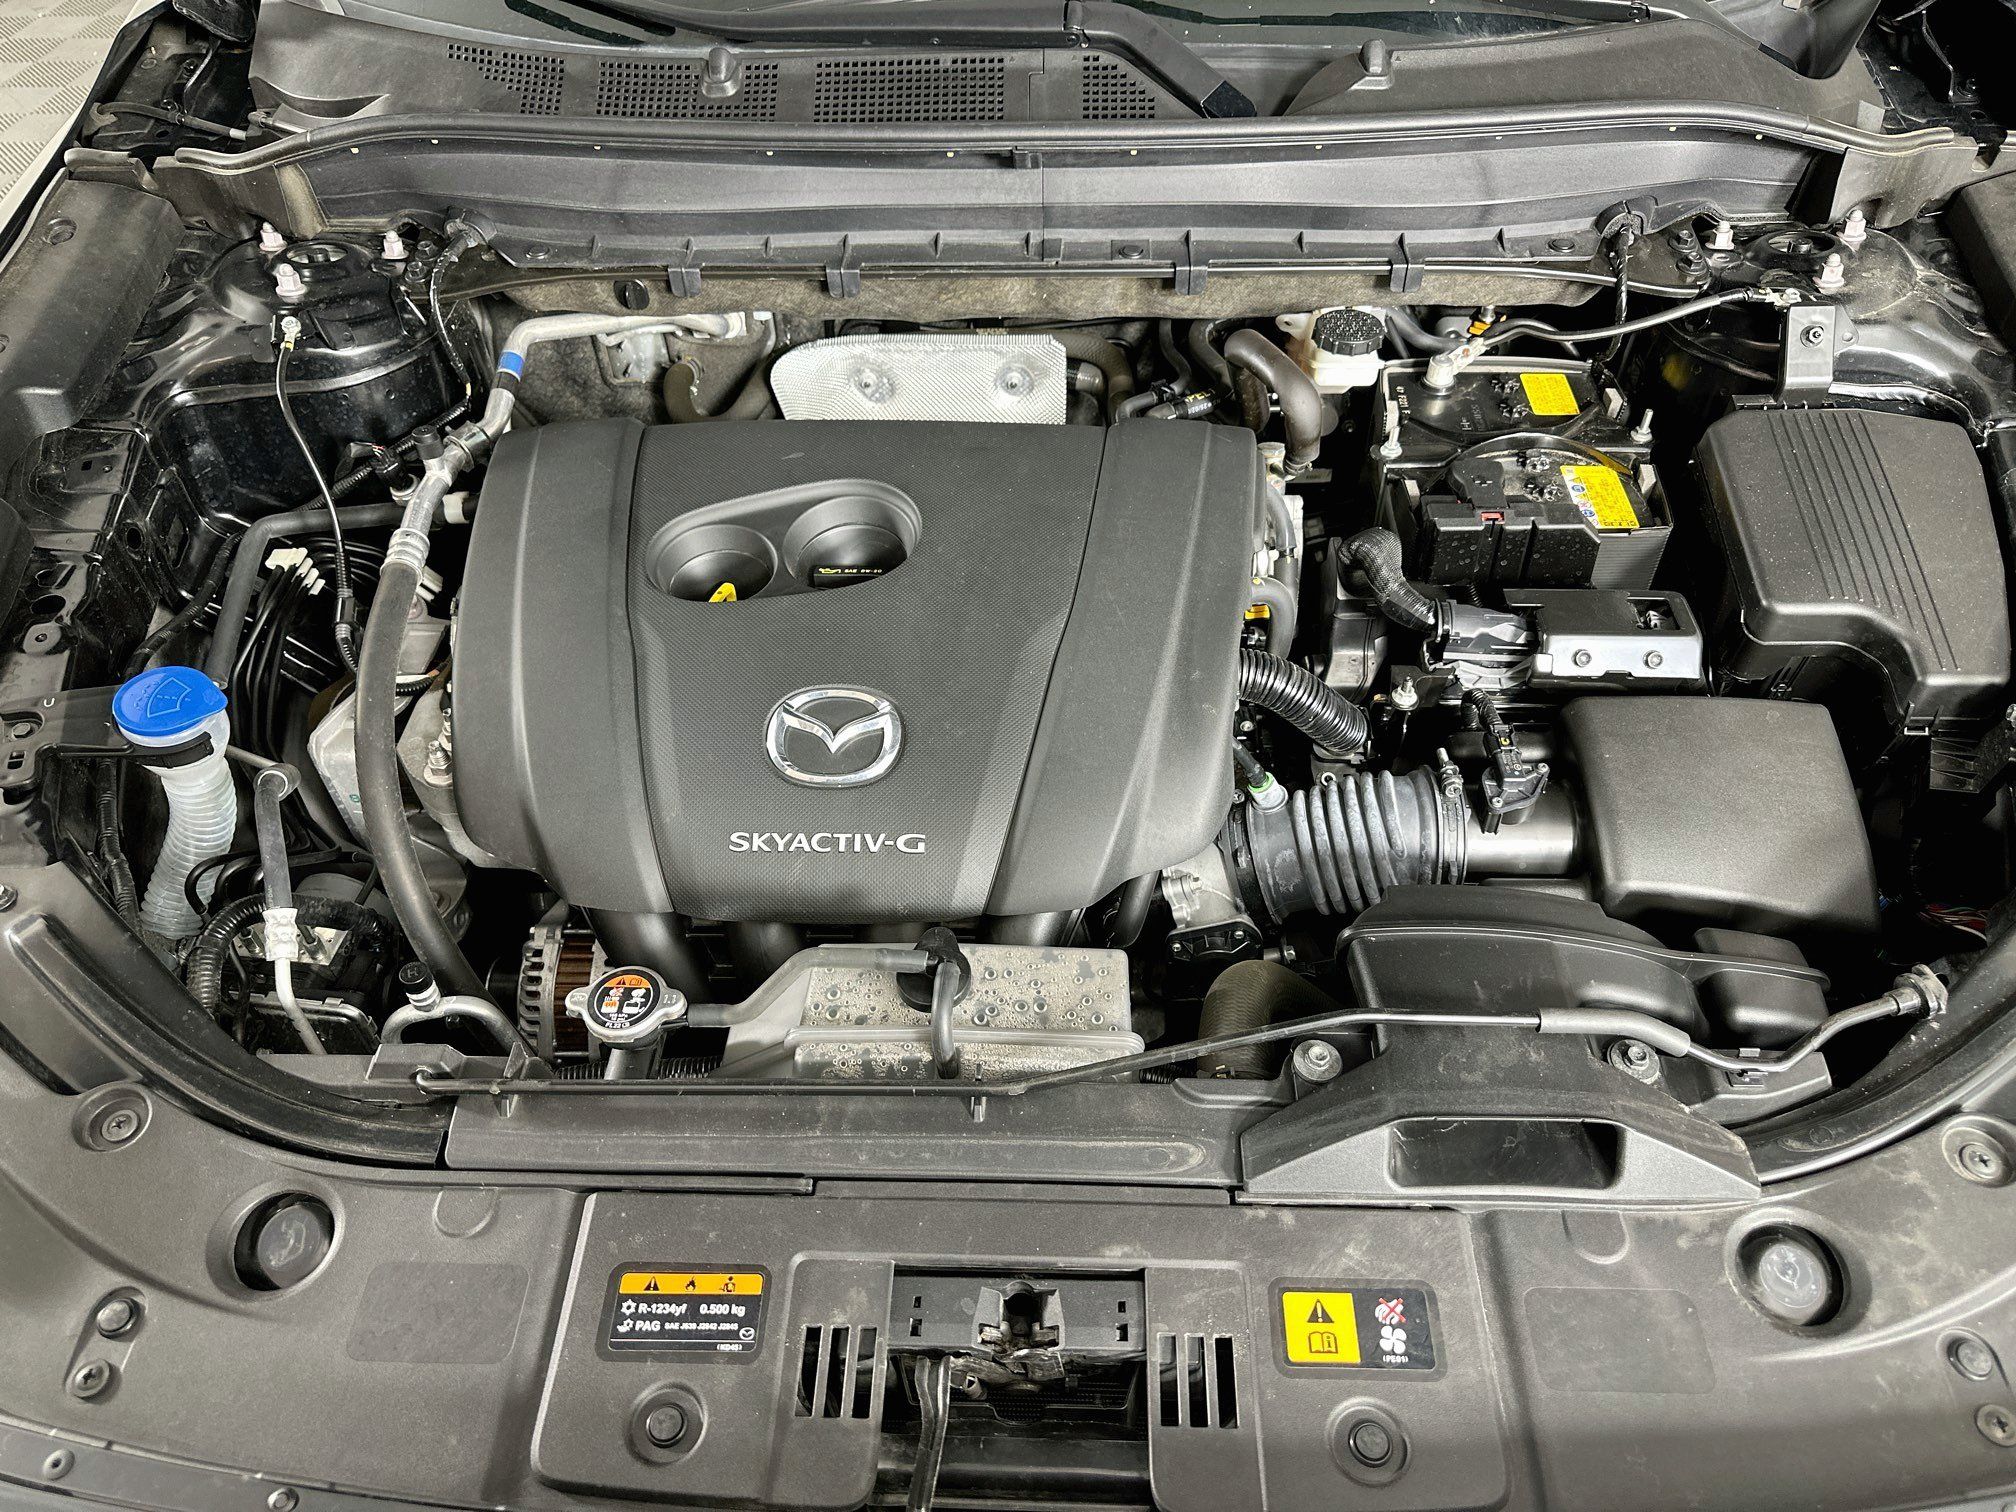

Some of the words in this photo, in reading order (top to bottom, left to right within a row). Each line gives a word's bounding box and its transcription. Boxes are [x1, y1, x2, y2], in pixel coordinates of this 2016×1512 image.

[728, 831, 926, 854] SKYACTIV-G
[637, 1302, 688, 1316] R-1234yf
[699, 1303, 730, 1315] 0.500
[730, 1303, 746, 1317] kg
[634, 1320, 661, 1331] PAG
[664, 1321, 680, 1330] SAE
